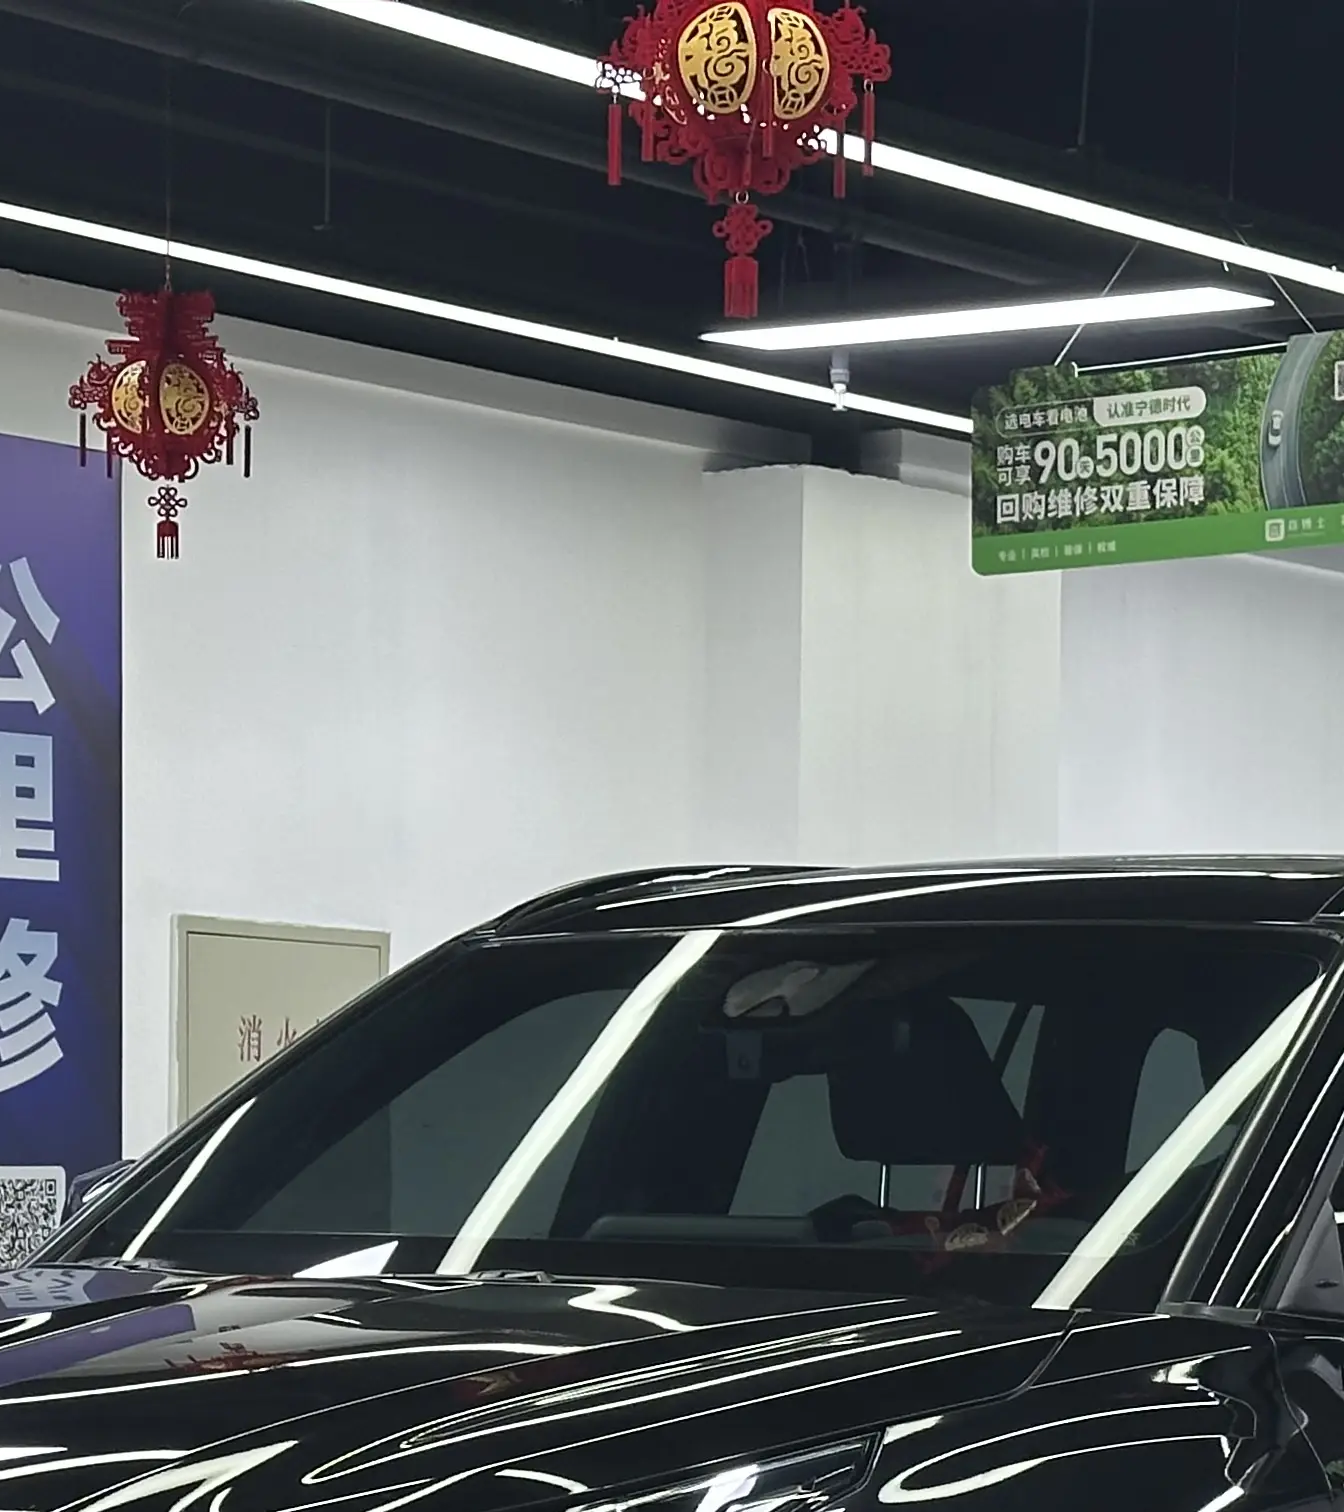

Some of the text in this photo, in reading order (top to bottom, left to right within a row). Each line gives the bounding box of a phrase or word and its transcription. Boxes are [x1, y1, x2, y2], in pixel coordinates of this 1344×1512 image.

[996, 474, 1205, 525] 回购维修双重保障
